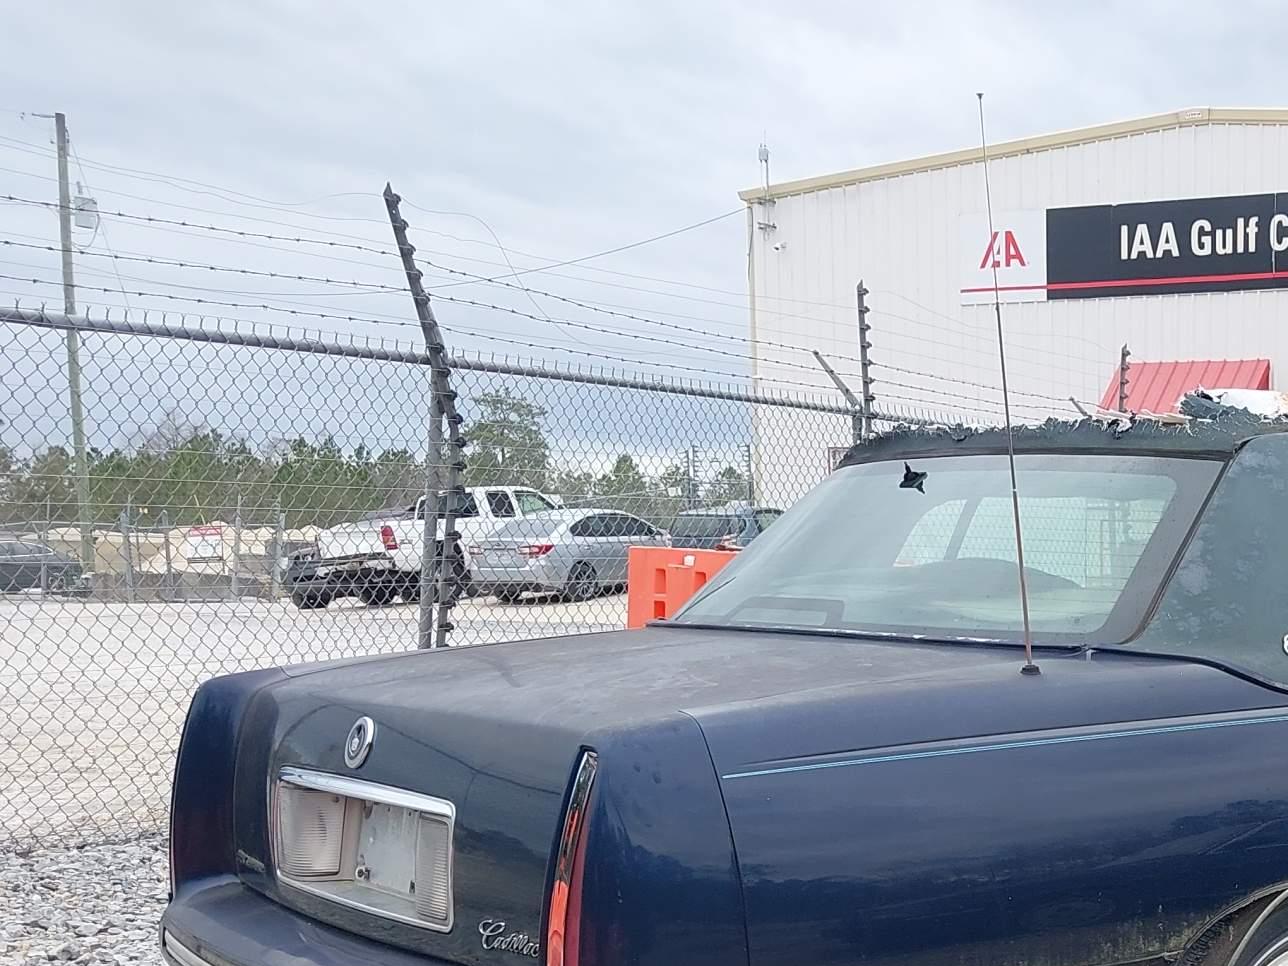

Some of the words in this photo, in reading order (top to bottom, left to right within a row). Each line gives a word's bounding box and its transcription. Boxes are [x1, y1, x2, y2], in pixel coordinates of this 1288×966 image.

[1120, 222, 1180, 260] IAA
[1190, 216, 1259, 257] Gulf
[479, 919, 540, 957] Cadillac
